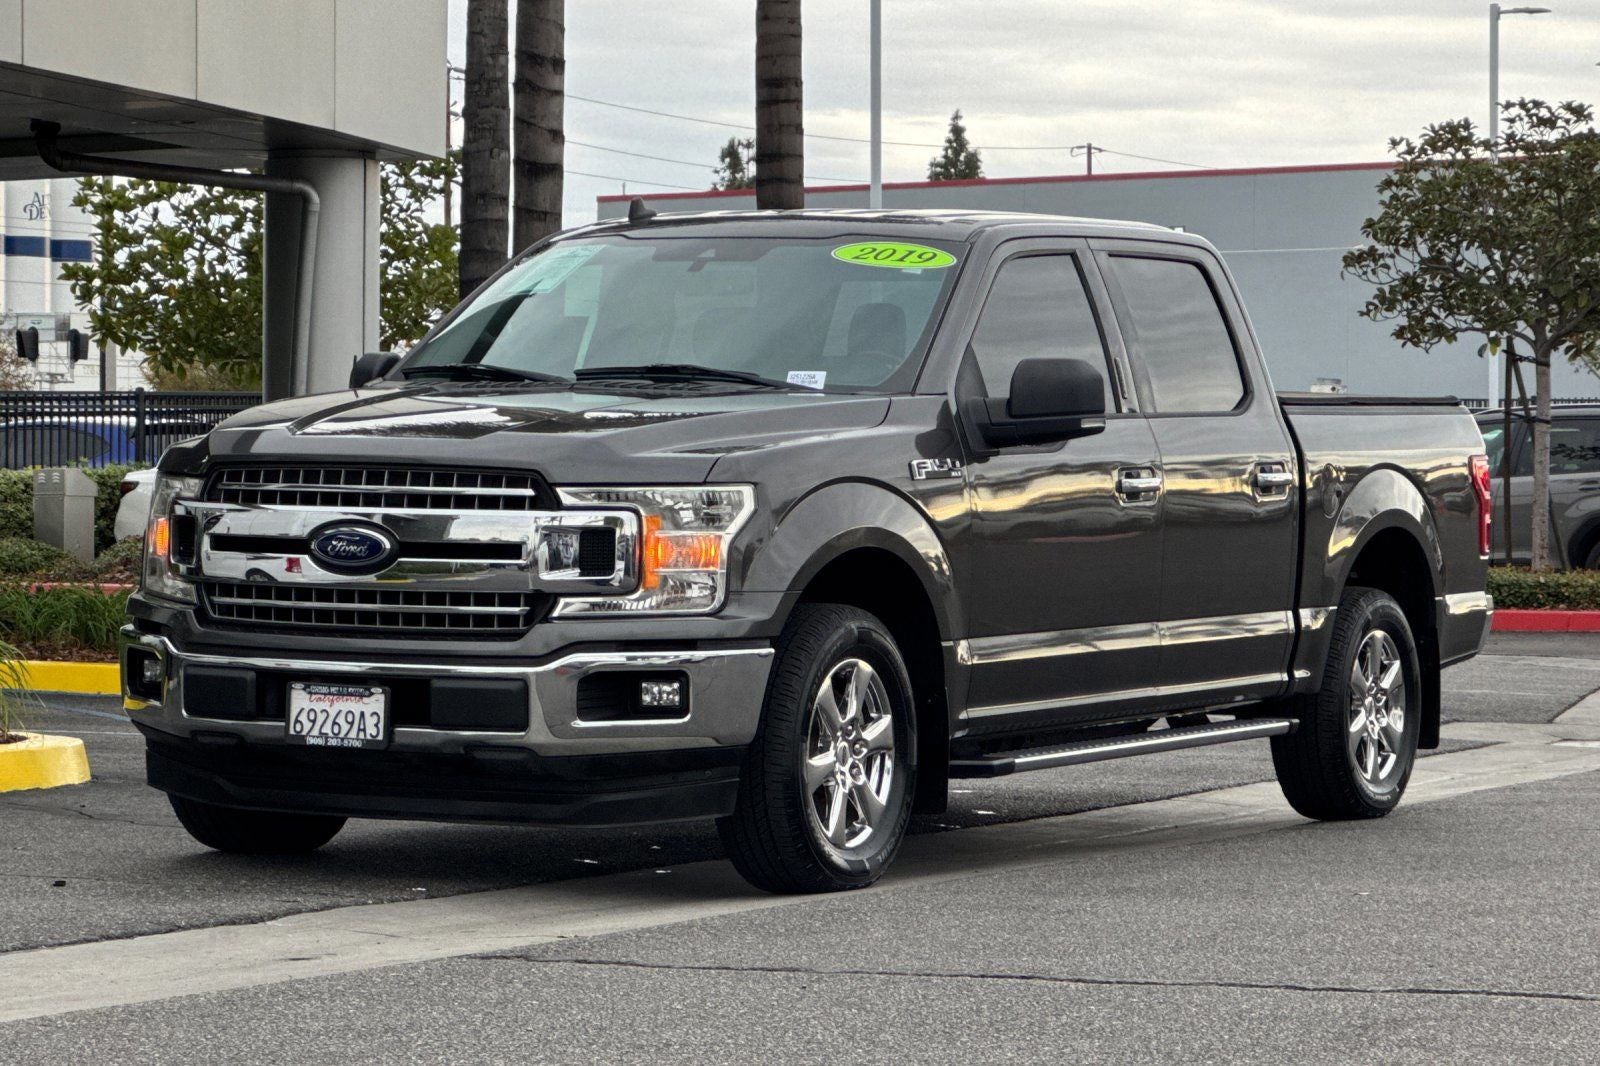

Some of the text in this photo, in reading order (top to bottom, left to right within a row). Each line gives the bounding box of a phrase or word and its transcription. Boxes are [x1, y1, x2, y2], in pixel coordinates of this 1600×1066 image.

[852, 247, 937, 264] 2019
[327, 535, 370, 557] Ford
[309, 694, 369, 707] California
[293, 707, 381, 739] 69269A3
